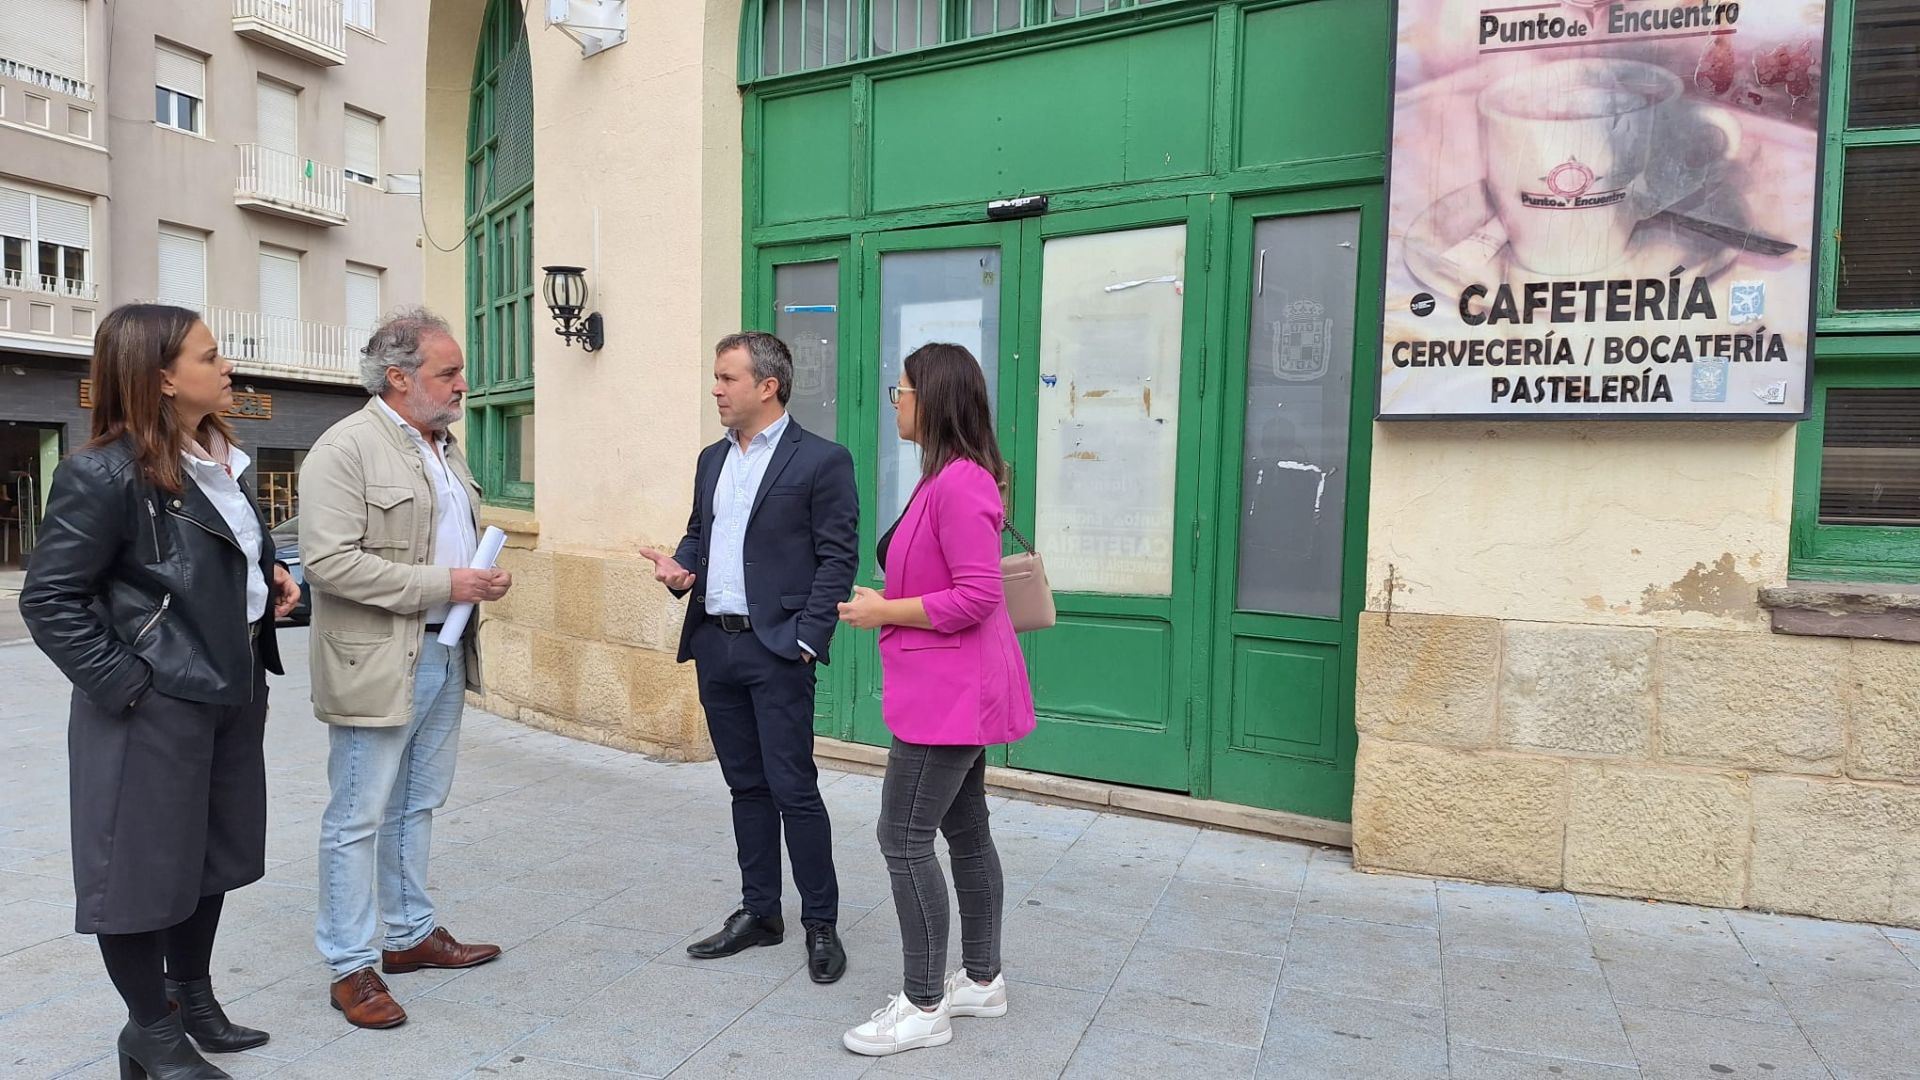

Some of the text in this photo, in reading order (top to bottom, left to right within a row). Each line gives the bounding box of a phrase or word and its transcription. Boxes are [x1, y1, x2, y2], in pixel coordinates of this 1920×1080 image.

[1479, 0, 1739, 45] Punto de Encuentro
[1521, 191, 1556, 206] Punto
[1574, 192, 1626, 206] Encuentro
[1459, 265, 1717, 326] CAFETERÍA
[1392, 326, 1788, 368] CERVECERÍA / BOCATERÍA
[1491, 367, 1673, 404] PASTELERÍA
